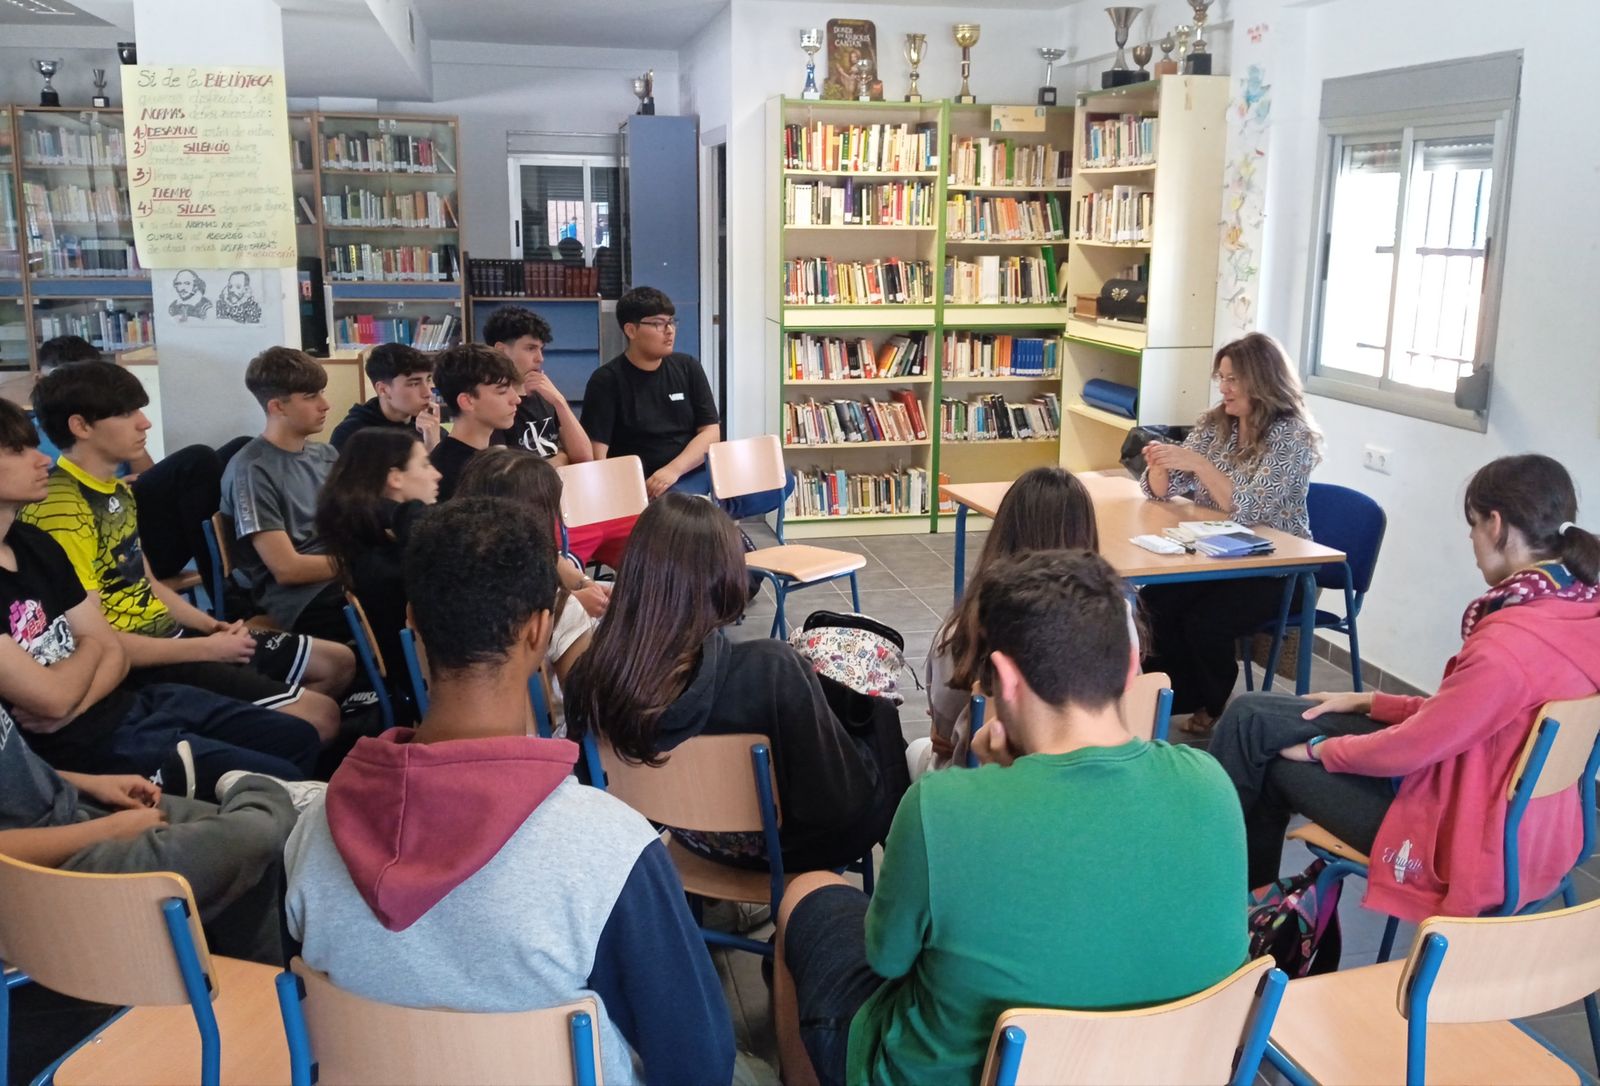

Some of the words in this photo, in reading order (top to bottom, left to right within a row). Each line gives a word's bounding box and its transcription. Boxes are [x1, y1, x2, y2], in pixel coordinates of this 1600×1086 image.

[137, 70, 157, 88] Si
[162, 68, 181, 88] de
[187, 68, 202, 88] la
[140, 107, 186, 121] NORMAS
[147, 126, 198, 137] DESAYUNO
[183, 140, 230, 153] SILENCIO
[152, 187, 193, 199] TIEMPO
[177, 201, 216, 214] SILLAS
